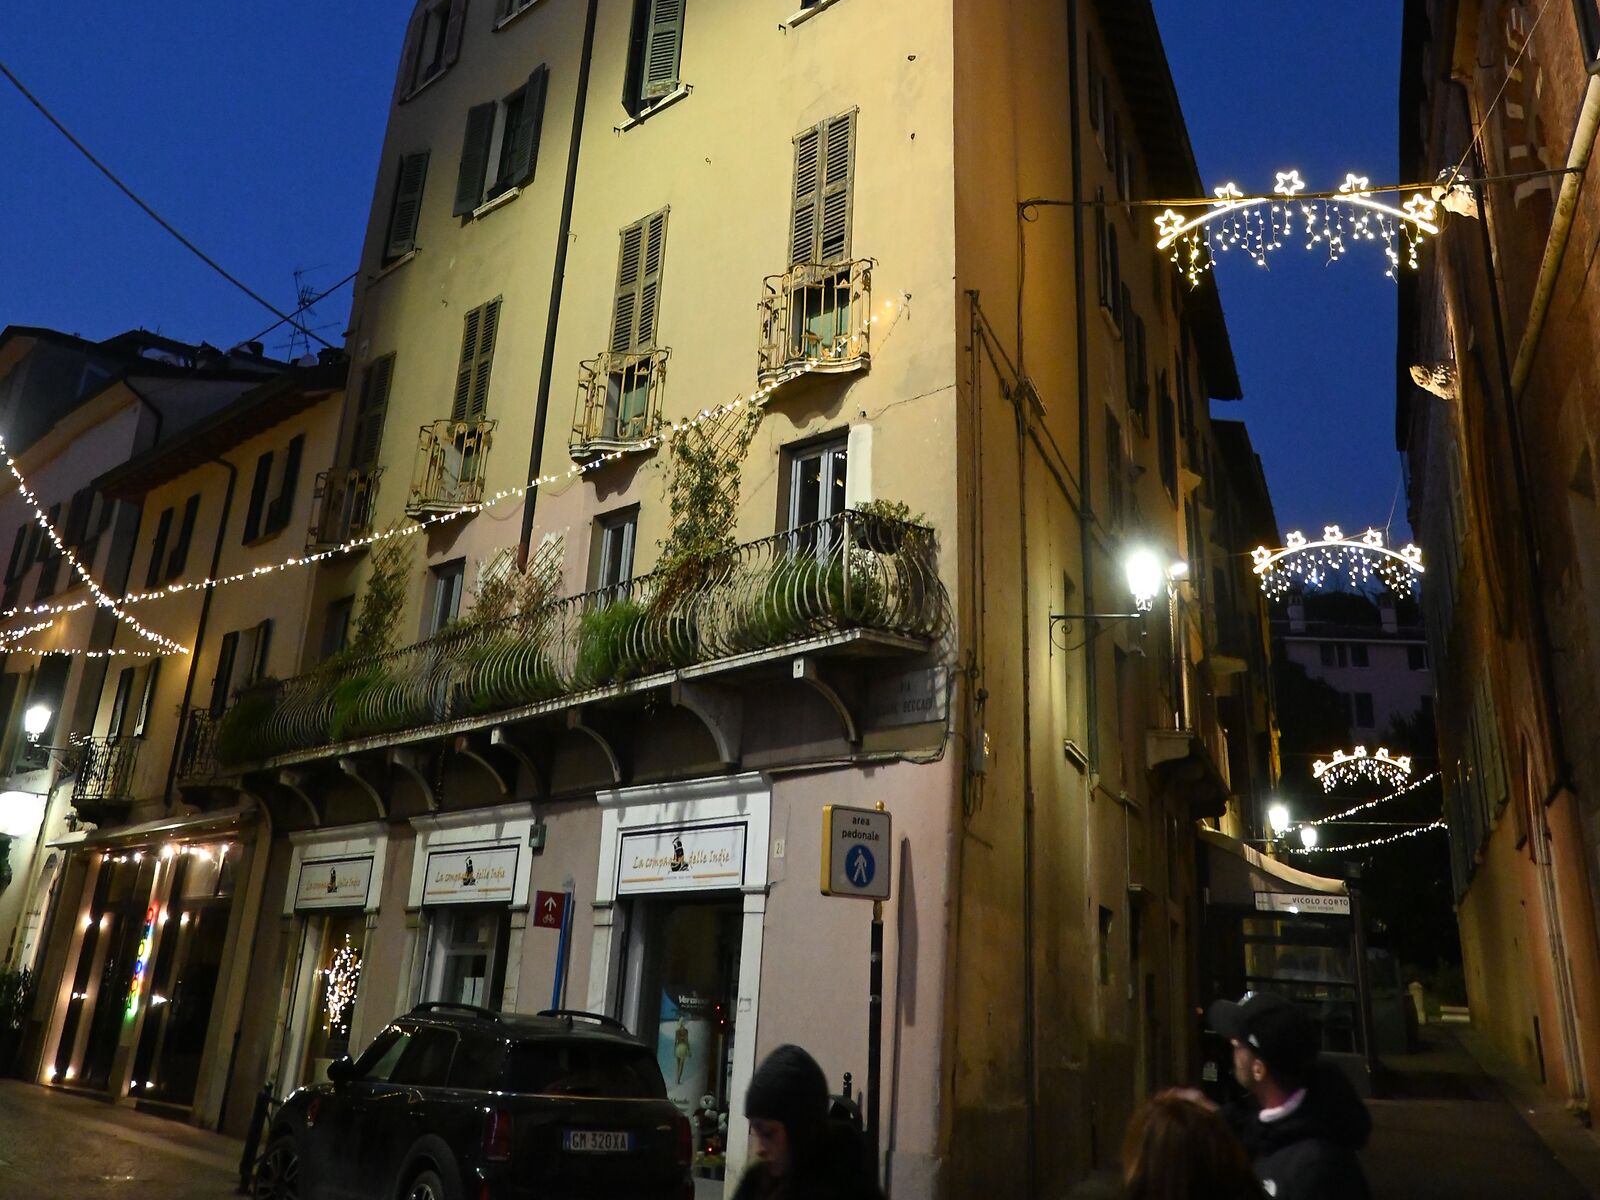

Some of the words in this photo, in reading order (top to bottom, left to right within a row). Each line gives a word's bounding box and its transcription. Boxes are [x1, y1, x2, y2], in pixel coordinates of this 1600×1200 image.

[852, 816, 870, 826] area
[842, 829, 880, 841] pedonale
[632, 856, 644, 869] La
[688, 850, 707, 867] delle
[709, 848, 730, 866] Indie
[1292, 897, 1320, 905] VICOLO
